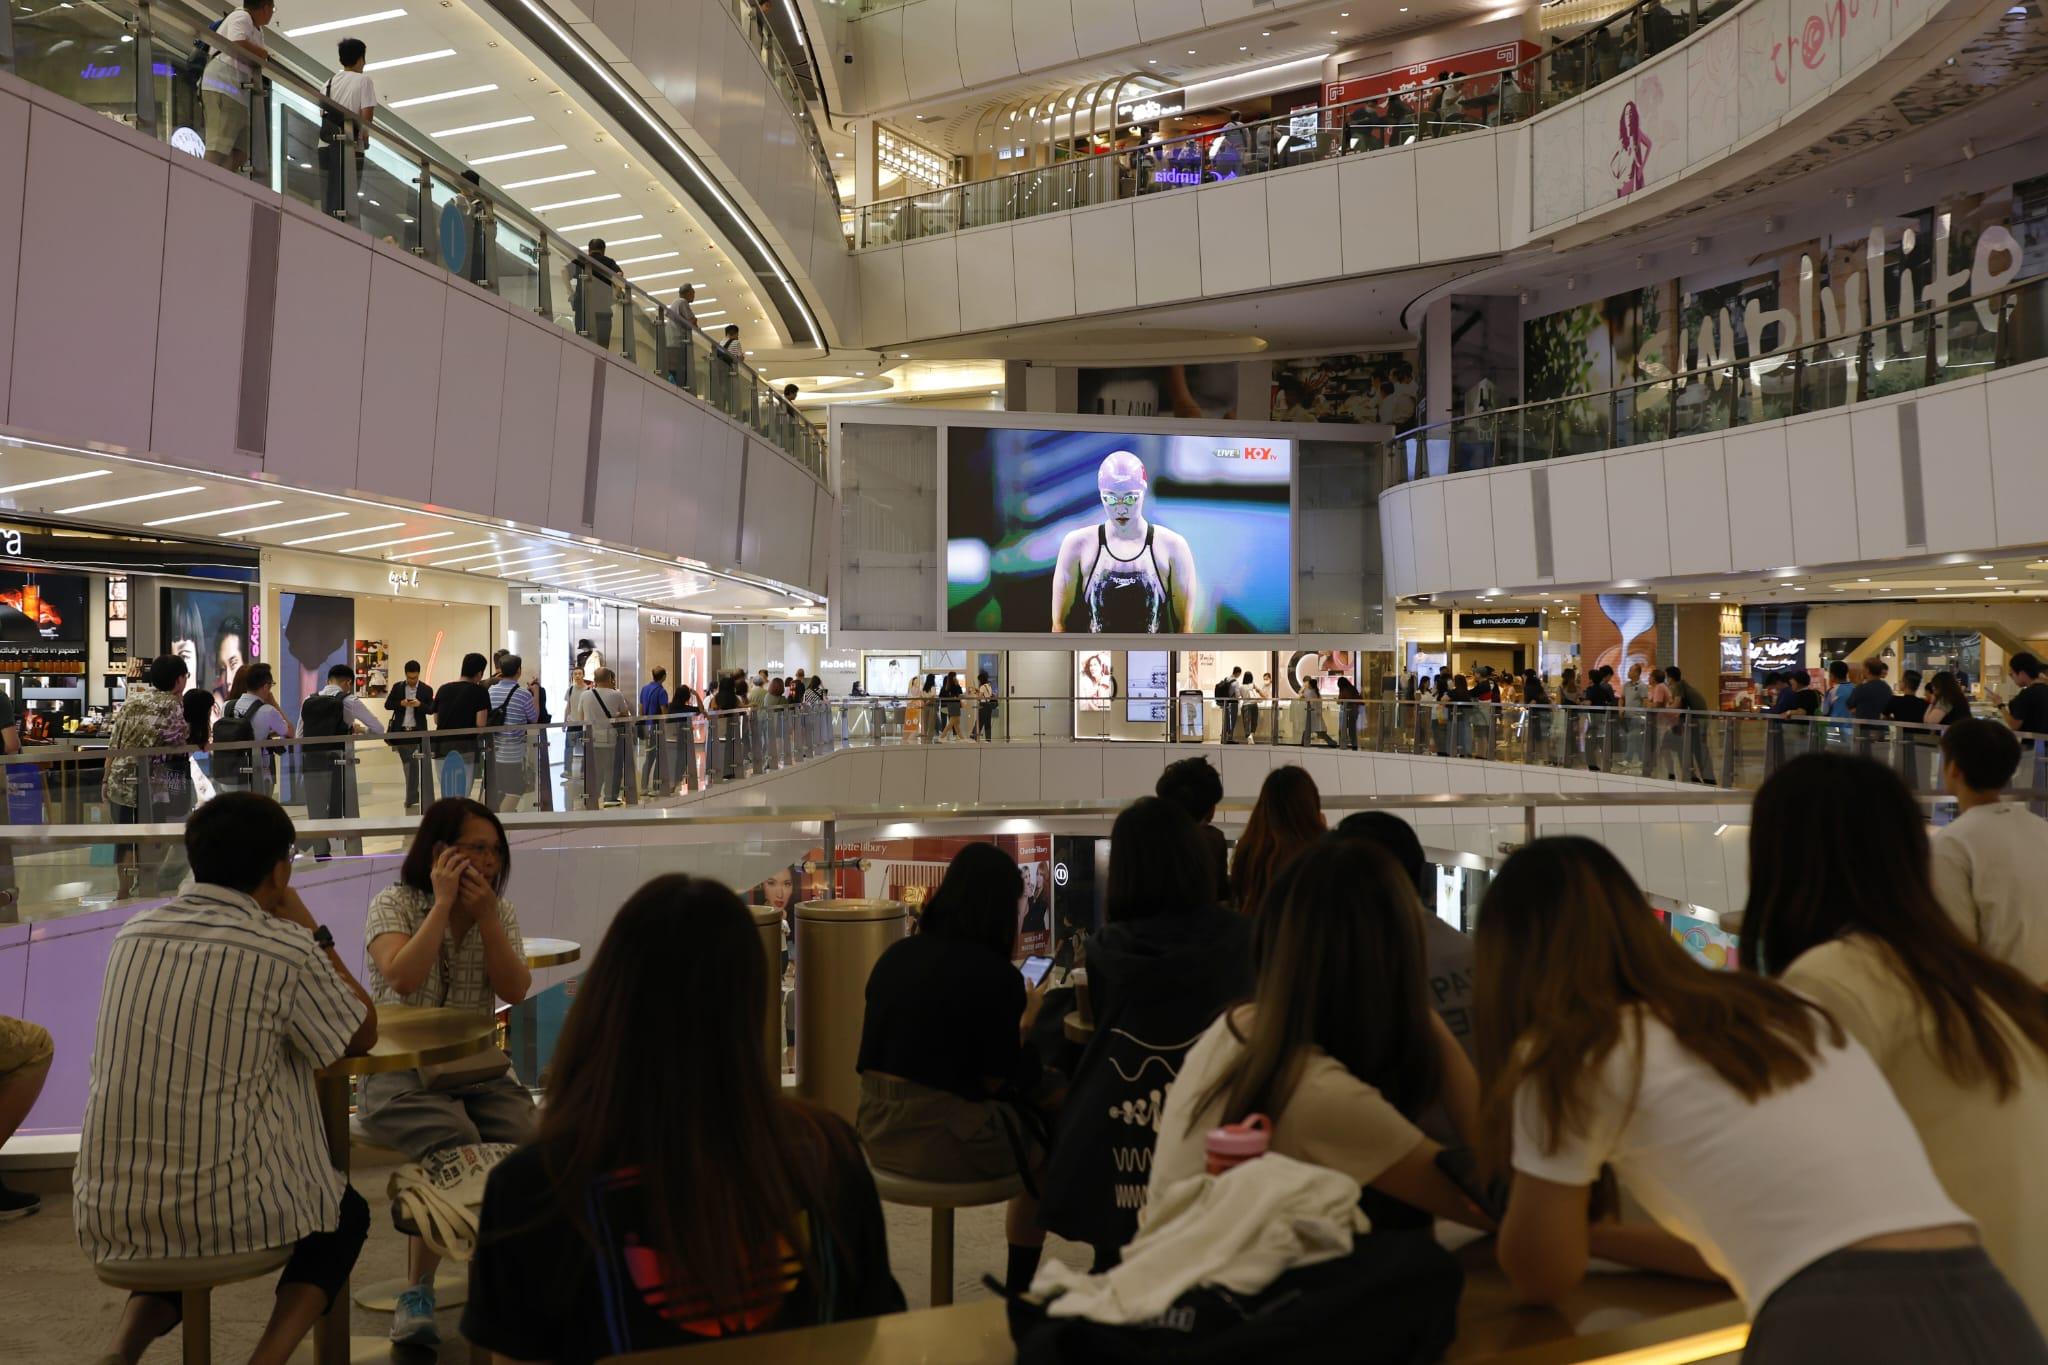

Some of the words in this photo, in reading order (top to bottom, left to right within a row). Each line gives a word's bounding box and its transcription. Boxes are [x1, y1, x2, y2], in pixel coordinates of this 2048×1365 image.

[1217, 449, 1235, 457] LIVE
[1245, 448, 1271, 460] HOY
[58, 647, 80, 655] japan
